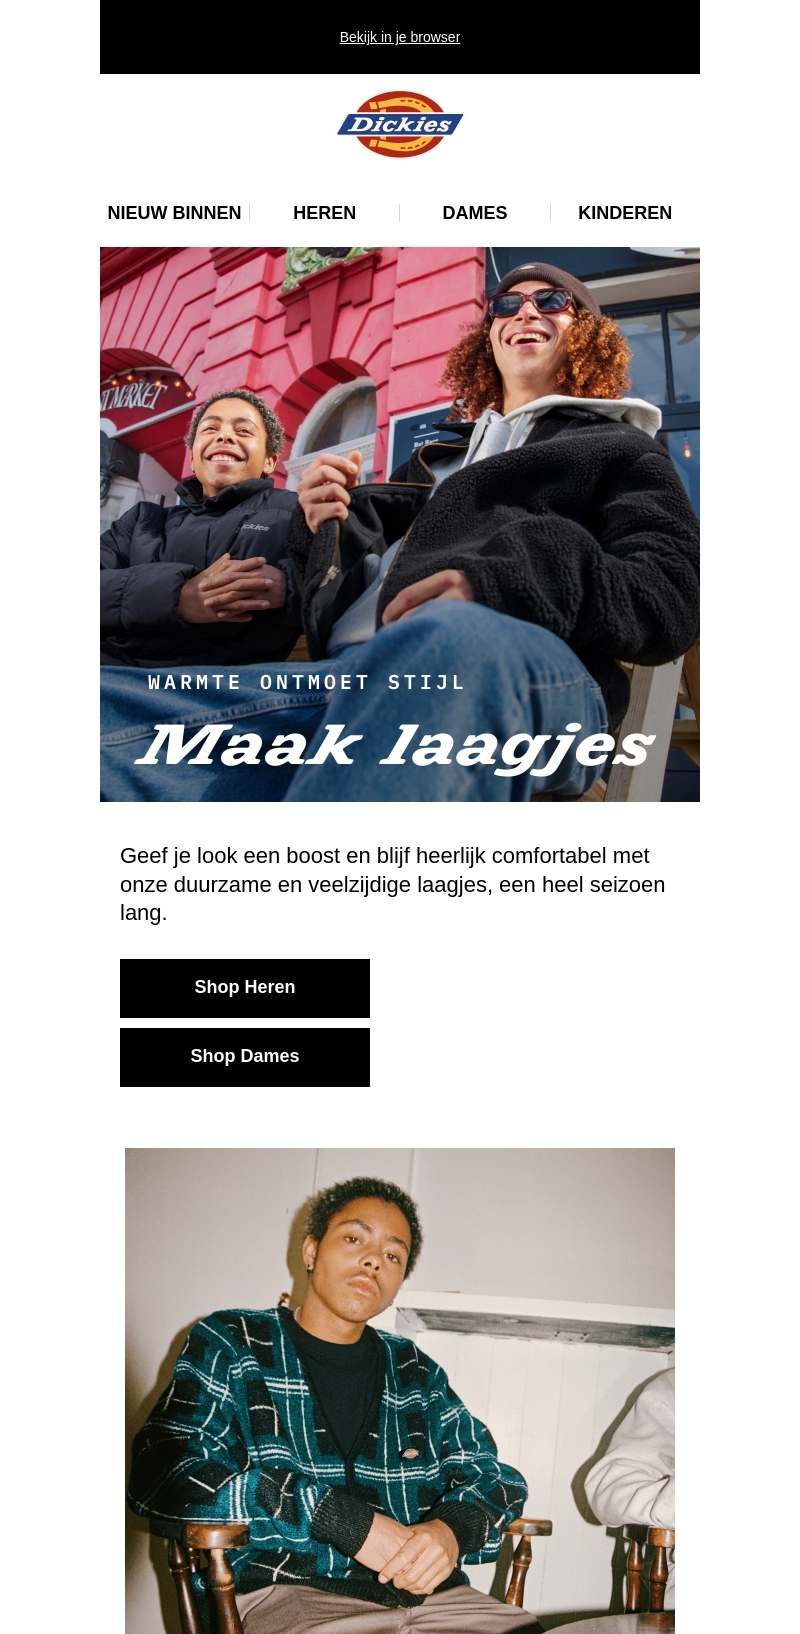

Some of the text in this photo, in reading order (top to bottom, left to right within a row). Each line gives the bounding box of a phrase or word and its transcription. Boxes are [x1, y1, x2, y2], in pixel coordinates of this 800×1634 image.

[340, 30, 461, 46] Bekijk in je browser
[347, 116, 452, 133] Dickies
[107, 205, 242, 220] NIEUW BINNEN
[293, 205, 356, 220] HEREN
[442, 205, 508, 220] DAMES
[578, 205, 672, 220] KINDEREN
[236, 523, 270, 532] ickies
[120, 846, 651, 869] Geef je look een boost en blijf heerlijk comfortabel met
[120, 875, 665, 898] onze duurzame en veelzijdige laagjes, een heel seizoen
[120, 903, 167, 926] lang.
[194, 979, 296, 998] Shop Heren
[190, 1048, 300, 1067] Shop Dames
